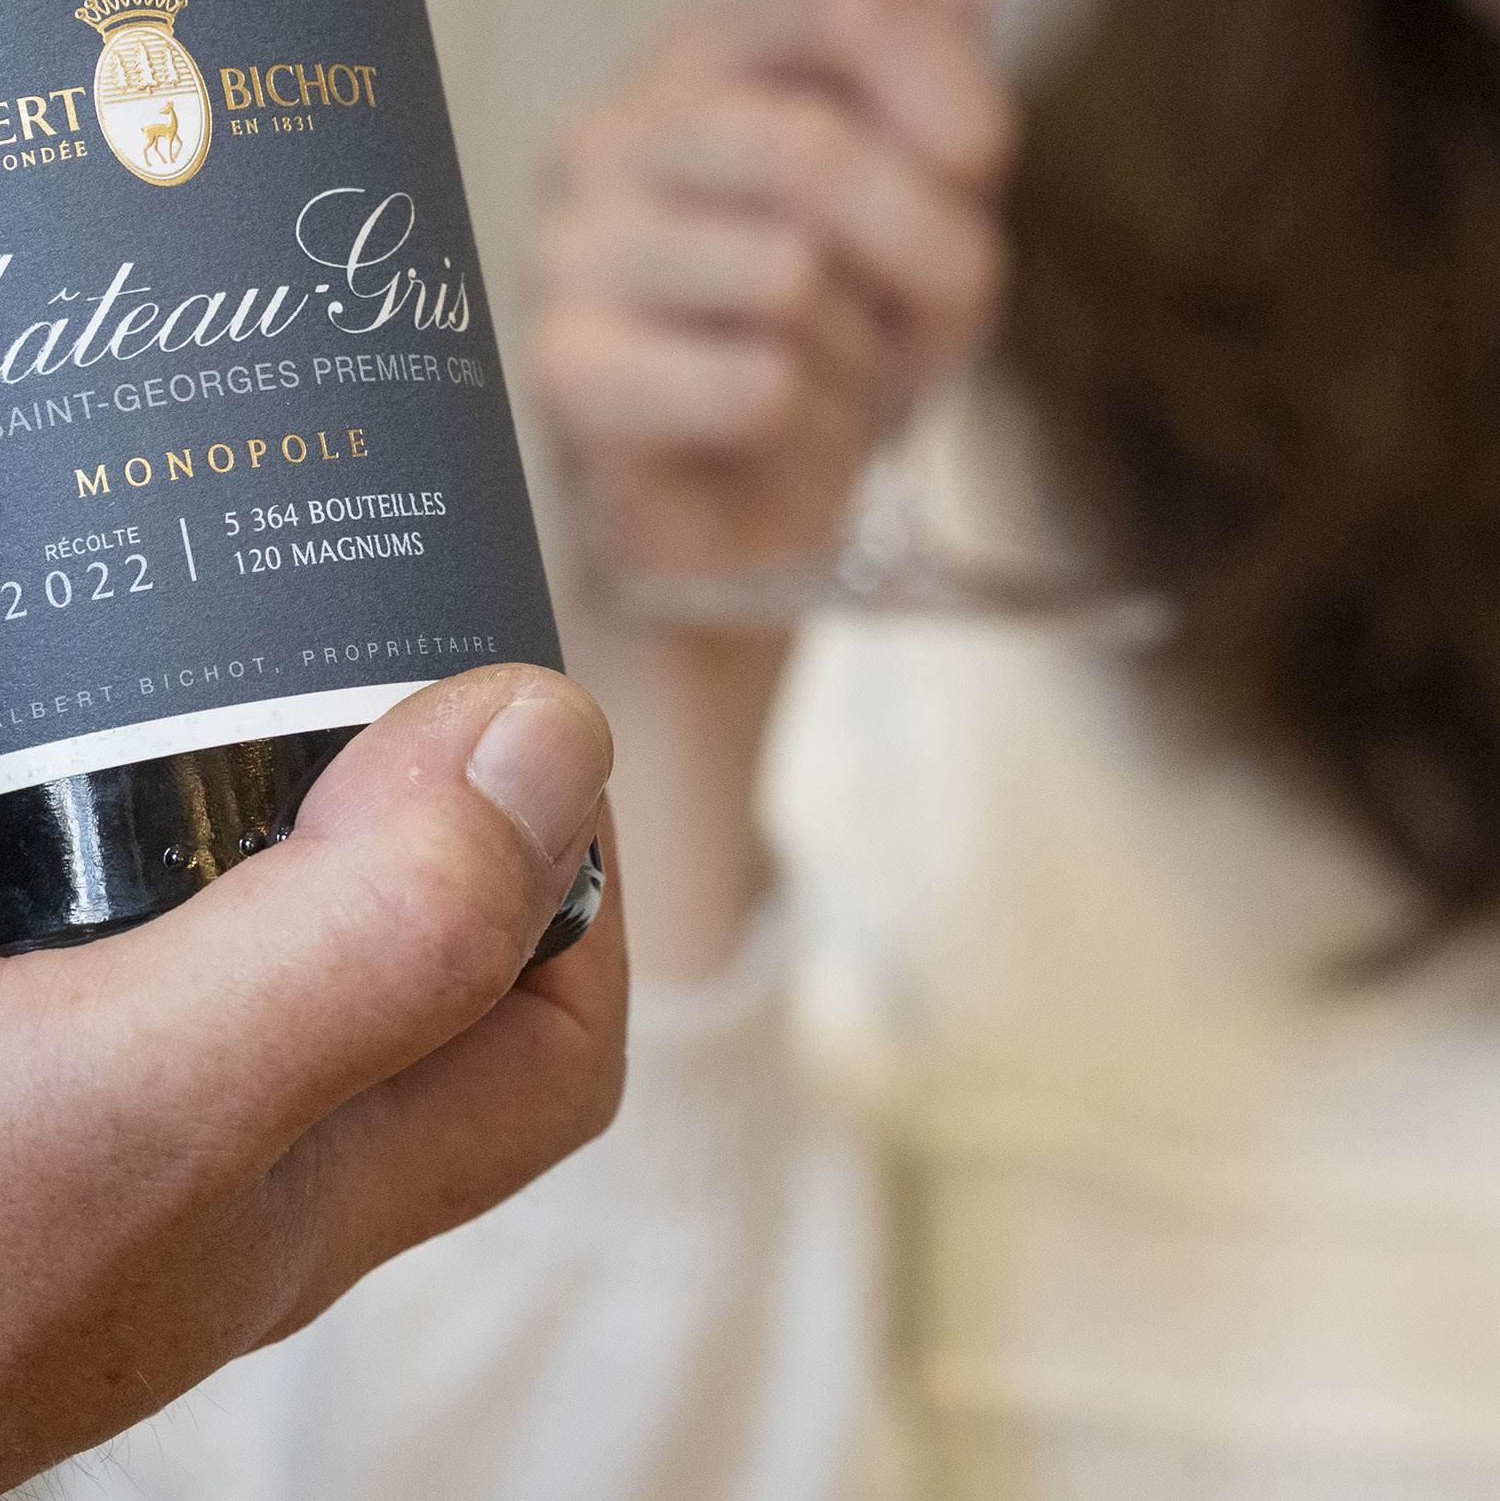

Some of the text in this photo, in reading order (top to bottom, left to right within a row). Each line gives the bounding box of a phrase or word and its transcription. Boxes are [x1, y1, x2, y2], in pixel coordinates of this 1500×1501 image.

[220, 63, 378, 111] BICHOT
[231, 118, 260, 136] EN
[271, 114, 315, 133] 1831
[313, 354, 440, 386] PREMIER
[448, 357, 485, 389] CRU
[73, 428, 369, 499] MONOPOLE
[224, 491, 447, 537] 5 364 BOUTEILLES
[45, 526, 141, 563] RÉCOLTE
[234, 531, 425, 575] 120 MAGNUMS
[0, 554, 154, 621] 2022
[140, 657, 281, 696] BICHOT,
[303, 634, 498, 668] PROPRIÉTAIRE
